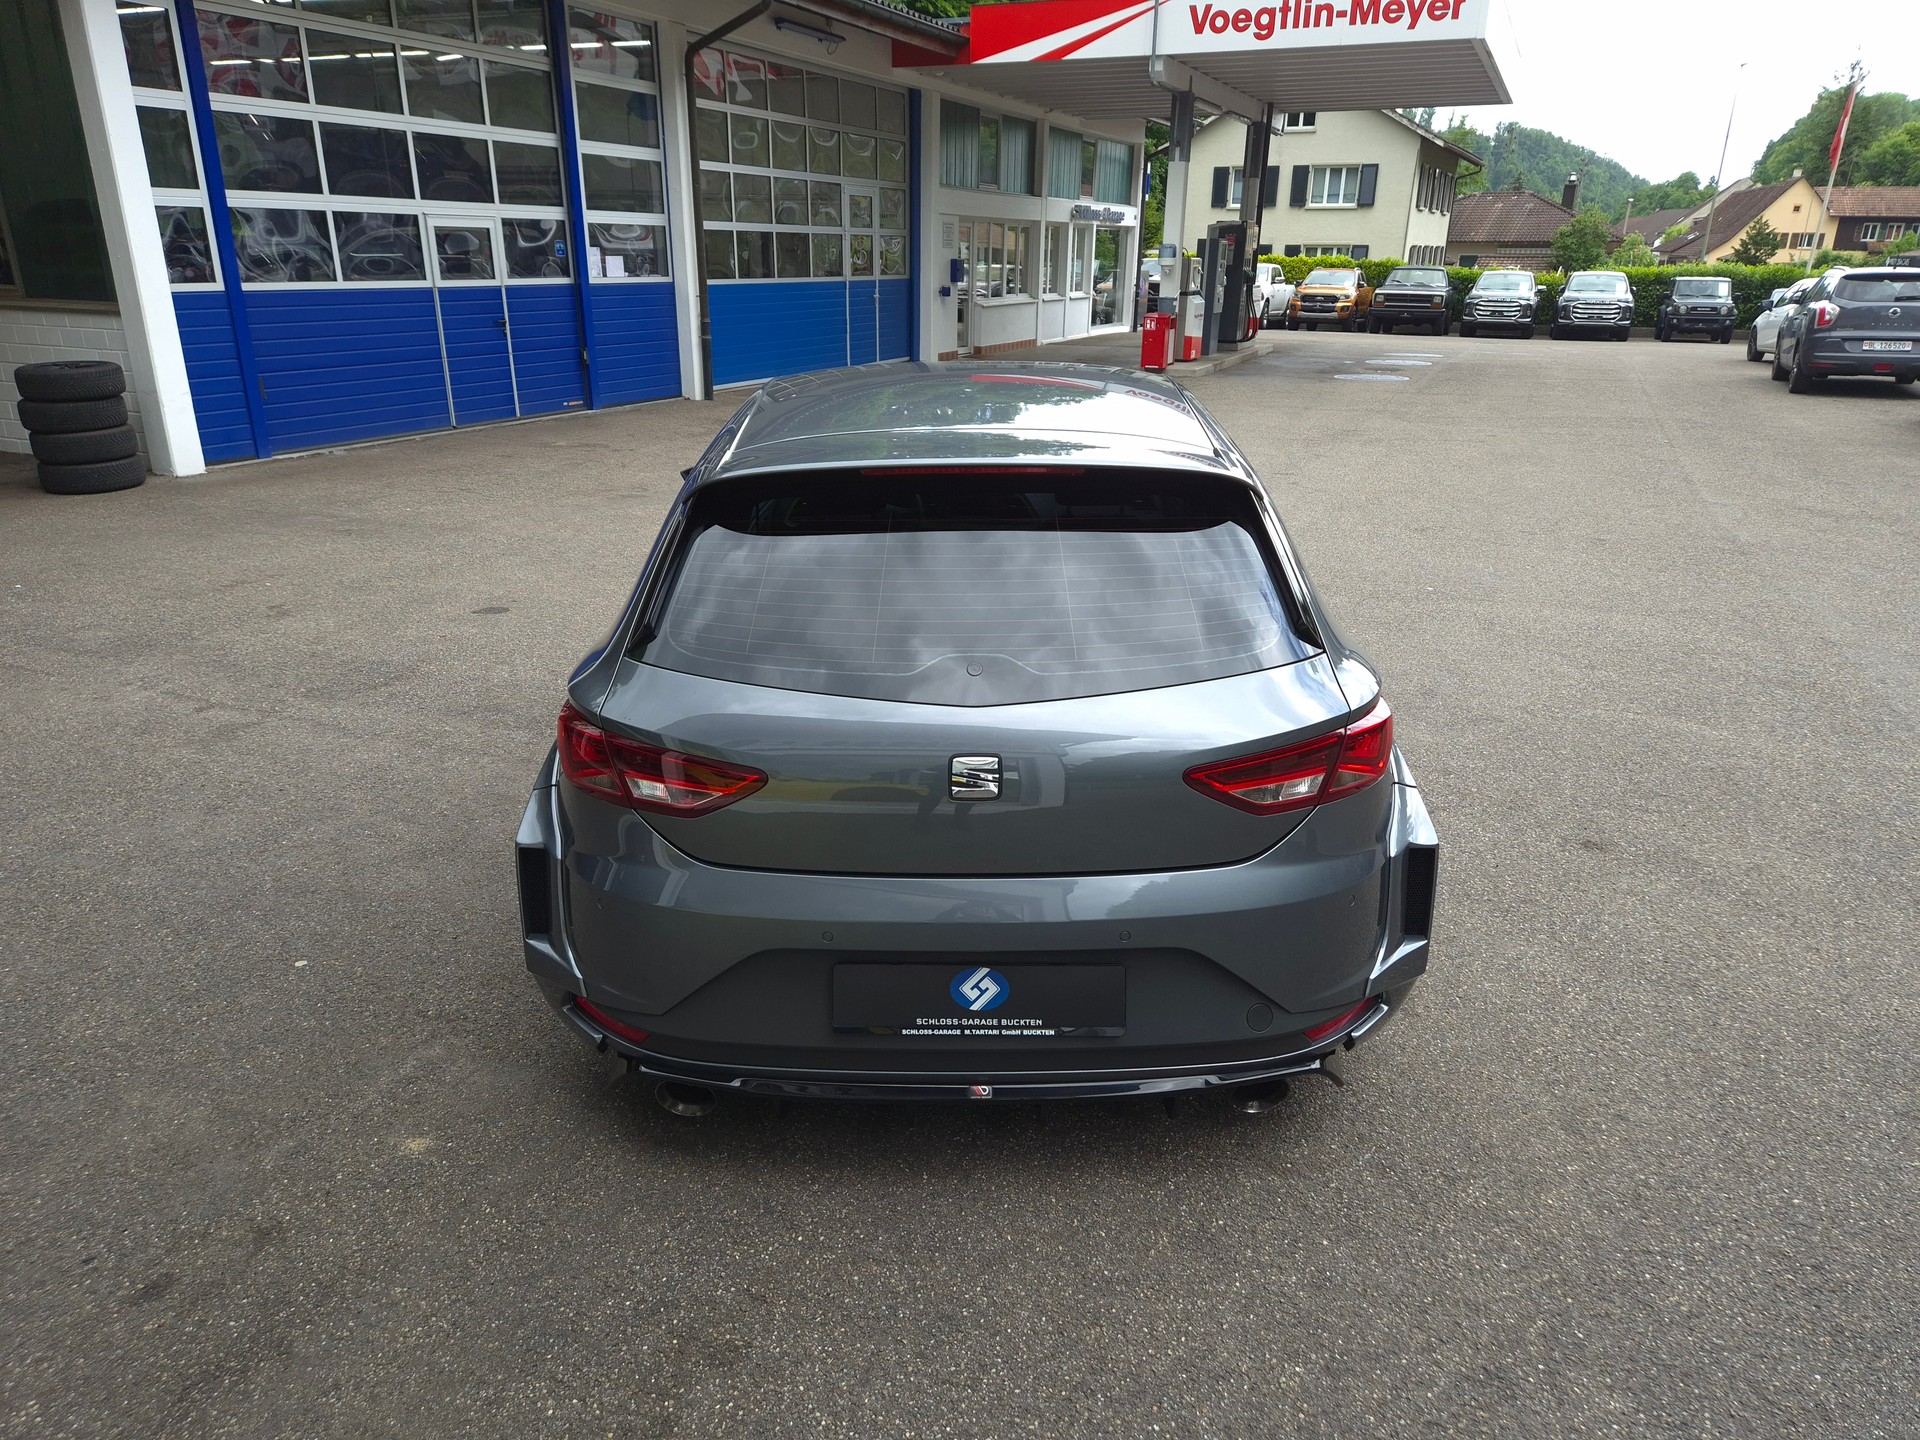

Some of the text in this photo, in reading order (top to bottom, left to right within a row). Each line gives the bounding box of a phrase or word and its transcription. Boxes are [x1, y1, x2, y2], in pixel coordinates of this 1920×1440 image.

[1188, 0, 1466, 41] Voegtlin-Meyer
[916, 1018, 1043, 1026] SCHLOSS-GARAGE BUCKTEN
[901, 1028, 962, 1036] SCHLOSS-GARAGE
